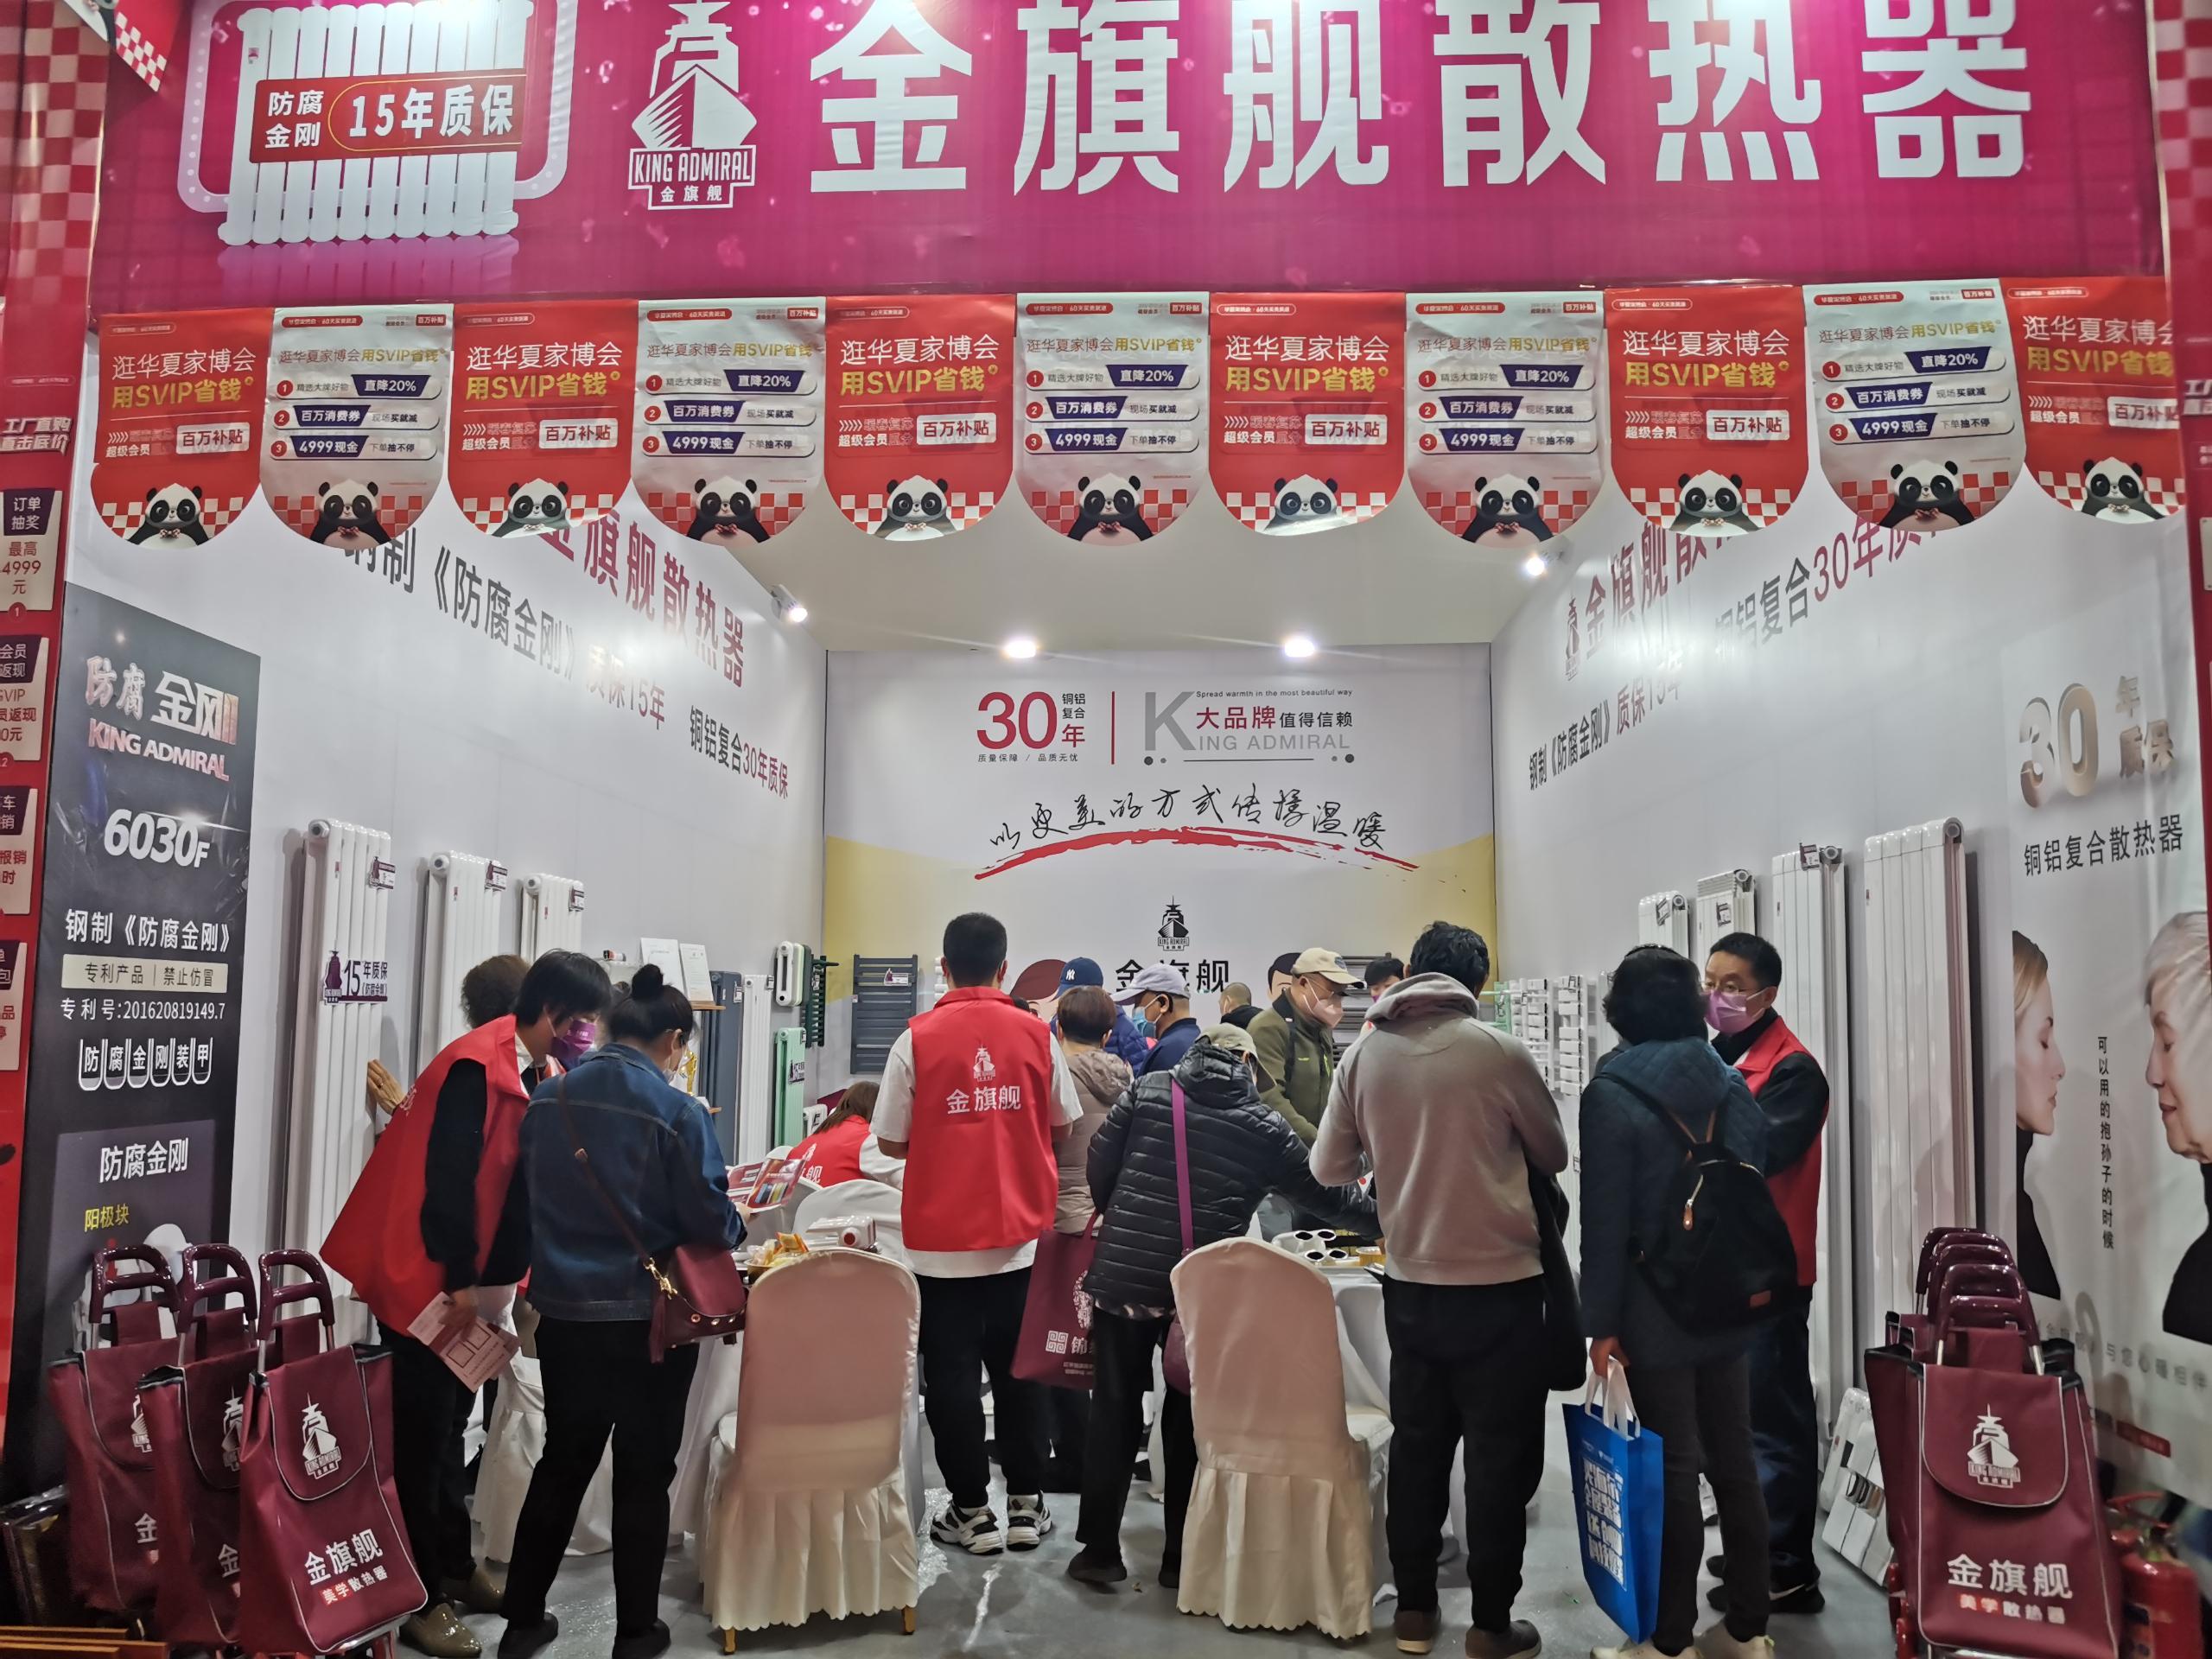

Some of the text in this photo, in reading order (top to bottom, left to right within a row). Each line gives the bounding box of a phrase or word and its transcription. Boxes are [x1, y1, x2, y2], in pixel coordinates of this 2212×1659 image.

[268, 92, 323, 118] 防腐
[810, 0, 2033, 195] 金旗舰散热器
[349, 85, 515, 140] 15年质保
[265, 123, 321, 149] 金刚
[634, 150, 753, 183] KING ADMIRAL
[661, 185, 723, 203] 金旗舰
[1565, 302, 1595, 312] 百万补贴
[1819, 321, 1996, 344] 逛华夏家博会用SVIP省钱
[2023, 315, 2173, 346] 逛华夏家博会
[840, 334, 1000, 366] 逛华夏家博会
[1027, 337, 1196, 353] 逛华夏家博会用SVIP省钱
[1224, 334, 1390, 363] 逛华夏家博会
[1417, 336, 1590, 353] 逛华夏家博会用SVIP省钱
[1623, 328, 1789, 357] 逛华夏家博会
[111, 347, 257, 381] 逛华夏家博会
[465, 341, 623, 372] 逛华夏家博会
[1921, 353, 1979, 368] 直降20%
[2028, 346, 2174, 378] 用SVIP省钱
[738, 374, 792, 389] 直降20%
[840, 365, 986, 397] 用SVIP省钱
[1119, 369, 1175, 384] 直降20%
[1224, 366, 1377, 393] 用SVIP省钱
[1514, 369, 1570, 384] 直降20%
[1624, 361, 1777, 389] 用SVIP省钱
[111, 378, 242, 410] 用SVIP省钱
[364, 378, 417, 393] 直降20%
[465, 372, 608, 401] 用SVIP省钱
[1856, 387, 1923, 405] 百万消费券
[1936, 385, 1986, 399] 现场买就减
[302, 410, 418, 423] 百万消费券 现场买就减
[672, 405, 794, 420] 百万消费券 现场买就减
[1055, 401, 1118, 416] 百万消费券
[1129, 404, 1177, 415] 现场买就减
[1450, 401, 1514, 416] 百万消费券
[1526, 404, 1574, 416] 现场买就减
[2114, 403, 2179, 423] 百万补贴
[4, 416, 72, 433] 工厂直购
[545, 424, 612, 443] 百万补贴
[923, 420, 990, 437] 百万补贴
[1311, 421, 1381, 438] 百万补贴
[1713, 416, 1783, 435] 百万补贴
[1861, 420, 1929, 437] 4999现金
[1940, 416, 1991, 430] 下单抽不停
[0, 435, 70, 455] 直击底价
[182, 429, 244, 448] 百万补贴
[299, 440, 416, 454] 4999现金 下单抽不停
[672, 436, 793, 451] 4999现金 下单抽不停
[1055, 432, 1118, 448] 4999现金
[1130, 435, 1177, 446] 下单抽不停
[1450, 433, 1515, 448] 4999现金
[1527, 435, 1575, 446] 下单抽不停
[14, 496, 41, 512] 订单
[11, 515, 41, 531] 抽奖
[9, 541, 38, 557] 最高
[0, 560, 41, 575] 4999
[12, 580, 27, 594] 元
[1062, 693, 1086, 705] 铜铝
[1196, 690, 1224, 699] Spread
[976, 691, 1058, 749] 30
[1062, 707, 1085, 719] 复合
[1061, 723, 1086, 748] 年
[1247, 734, 1351, 750] ADMIRAL
[88, 718, 230, 782] KING ADMIRAL
[977, 753, 1079, 763] 质量保障 品质无忧
[990, 783, 1387, 850] 以更美的方式传播温暖
[104, 809, 210, 868] 6030F
[2024, 813, 2183, 877] 铜铝复合散热器
[85, 963, 214, 988] 专利产品 禁止仿冒
[84, 1044, 209, 1074] 防腐金刚装甲
[946, 1085, 1021, 1115] 金旗舰
[2097, 1036, 2115, 1249] 可以用的抱孙子的时候
[99, 1137, 189, 1184] 防腐金刚
[84, 1204, 130, 1233] 阳极块
[304, 1529, 383, 1586] 金旗舰
[321, 1565, 389, 1605] 美学散热器
[1947, 1554, 2073, 1599] 金旗舰
